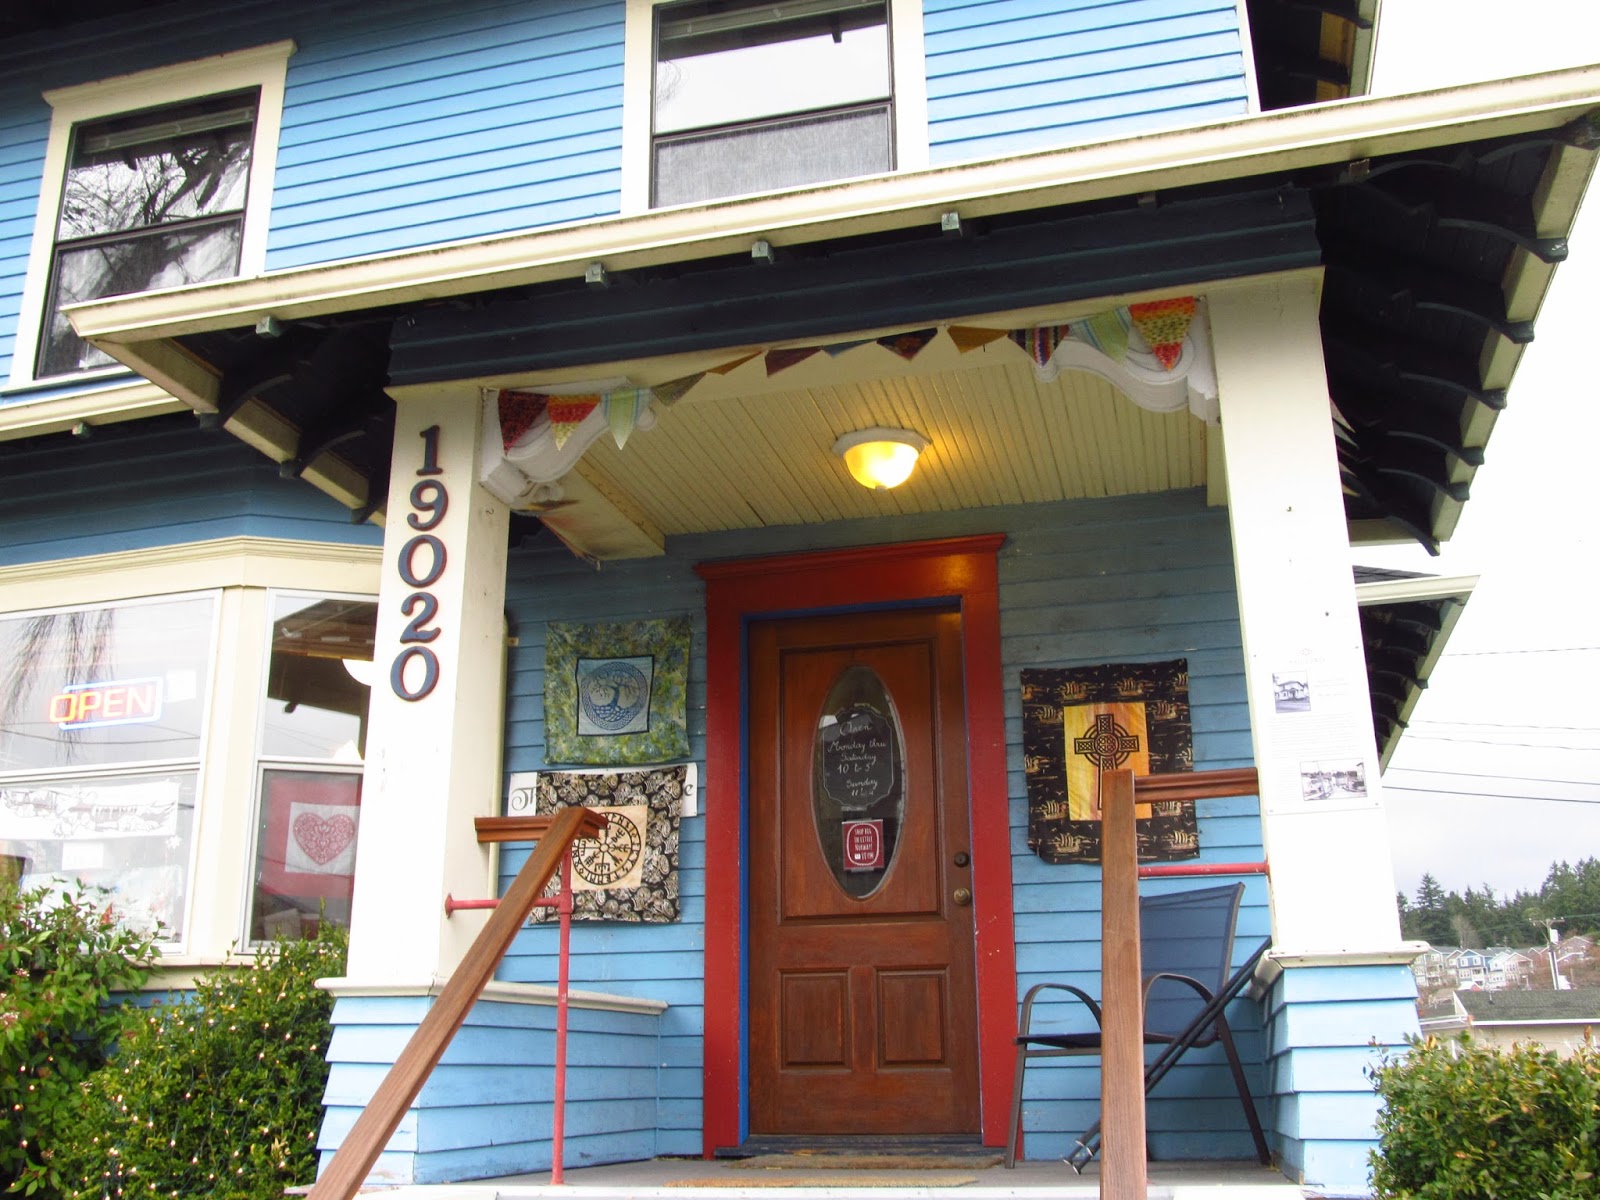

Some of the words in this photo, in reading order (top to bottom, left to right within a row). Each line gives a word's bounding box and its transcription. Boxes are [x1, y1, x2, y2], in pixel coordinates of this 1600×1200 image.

[390, 424, 449, 702] 19020
[49, 685, 153, 722] OPEN
[827, 740, 866, 753] Monday
[869, 738, 887, 748] thru
[841, 753, 877, 765] Saturday
[837, 763, 849, 774] 10
[846, 778, 878, 790] Sunday
